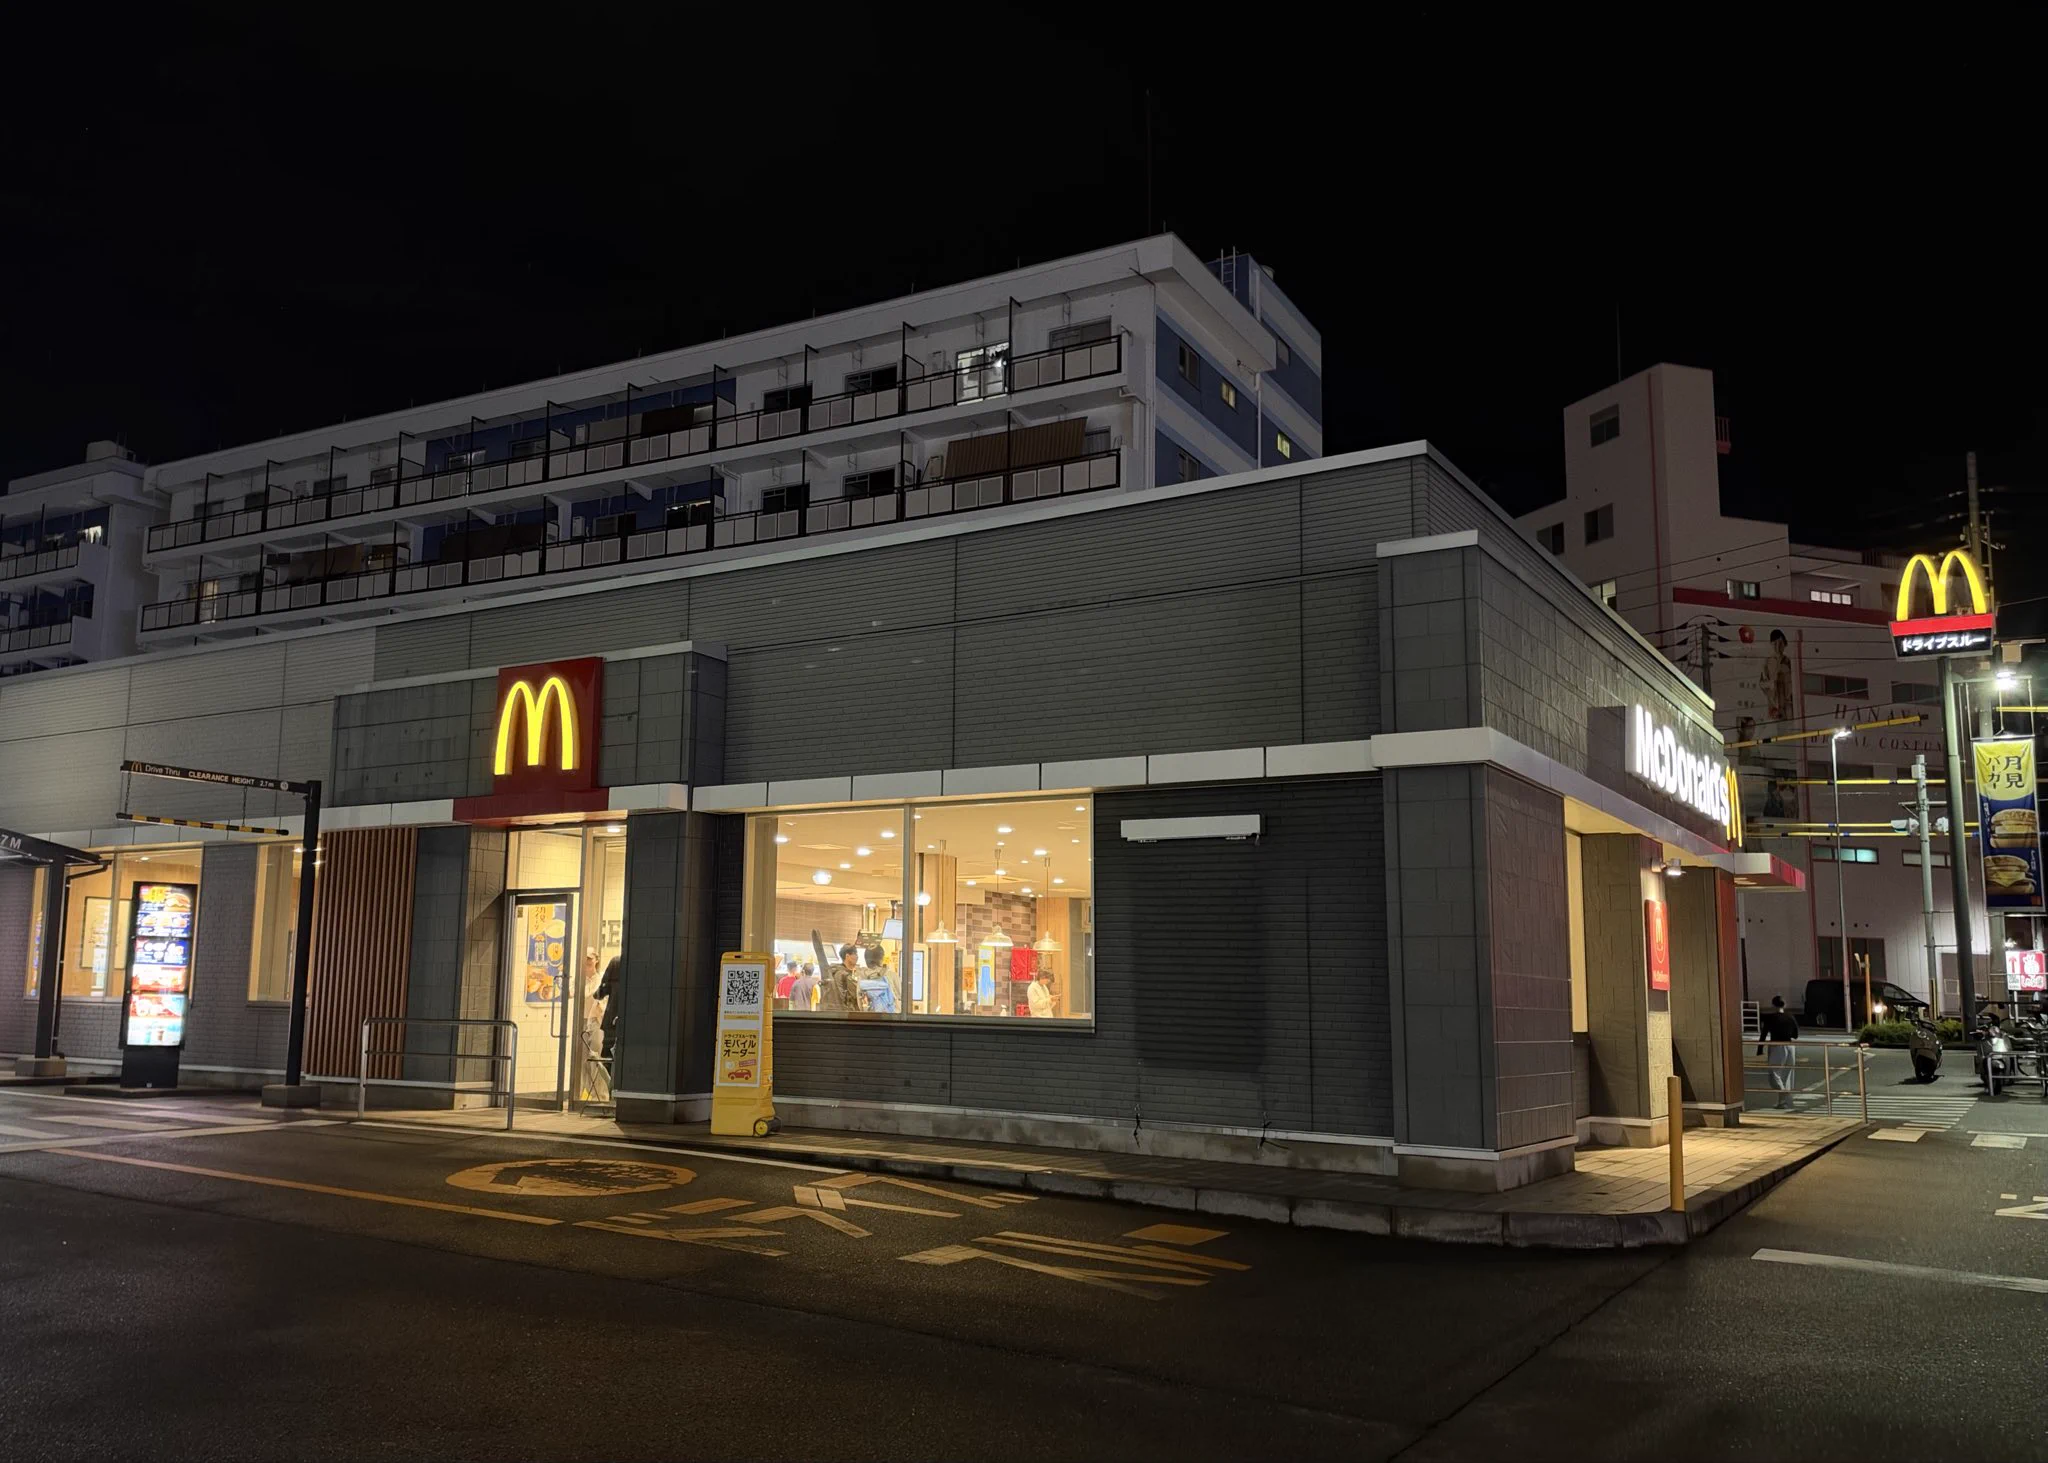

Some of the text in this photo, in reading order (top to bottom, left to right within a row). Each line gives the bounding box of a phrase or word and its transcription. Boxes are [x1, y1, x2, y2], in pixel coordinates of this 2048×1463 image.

[1902, 633, 1987, 652] ドライブスルー
[145, 764, 164, 775] Drive
[165, 767, 181, 777] Thru
[188, 770, 229, 783] CLEARANCE
[231, 777, 255, 786] HEIGHT
[1986, 755, 2001, 790] バーガー
[2003, 756, 2025, 789] 月見
[723, 1049, 756, 1058] オーダー
[724, 1040, 757, 1049] モバイル
